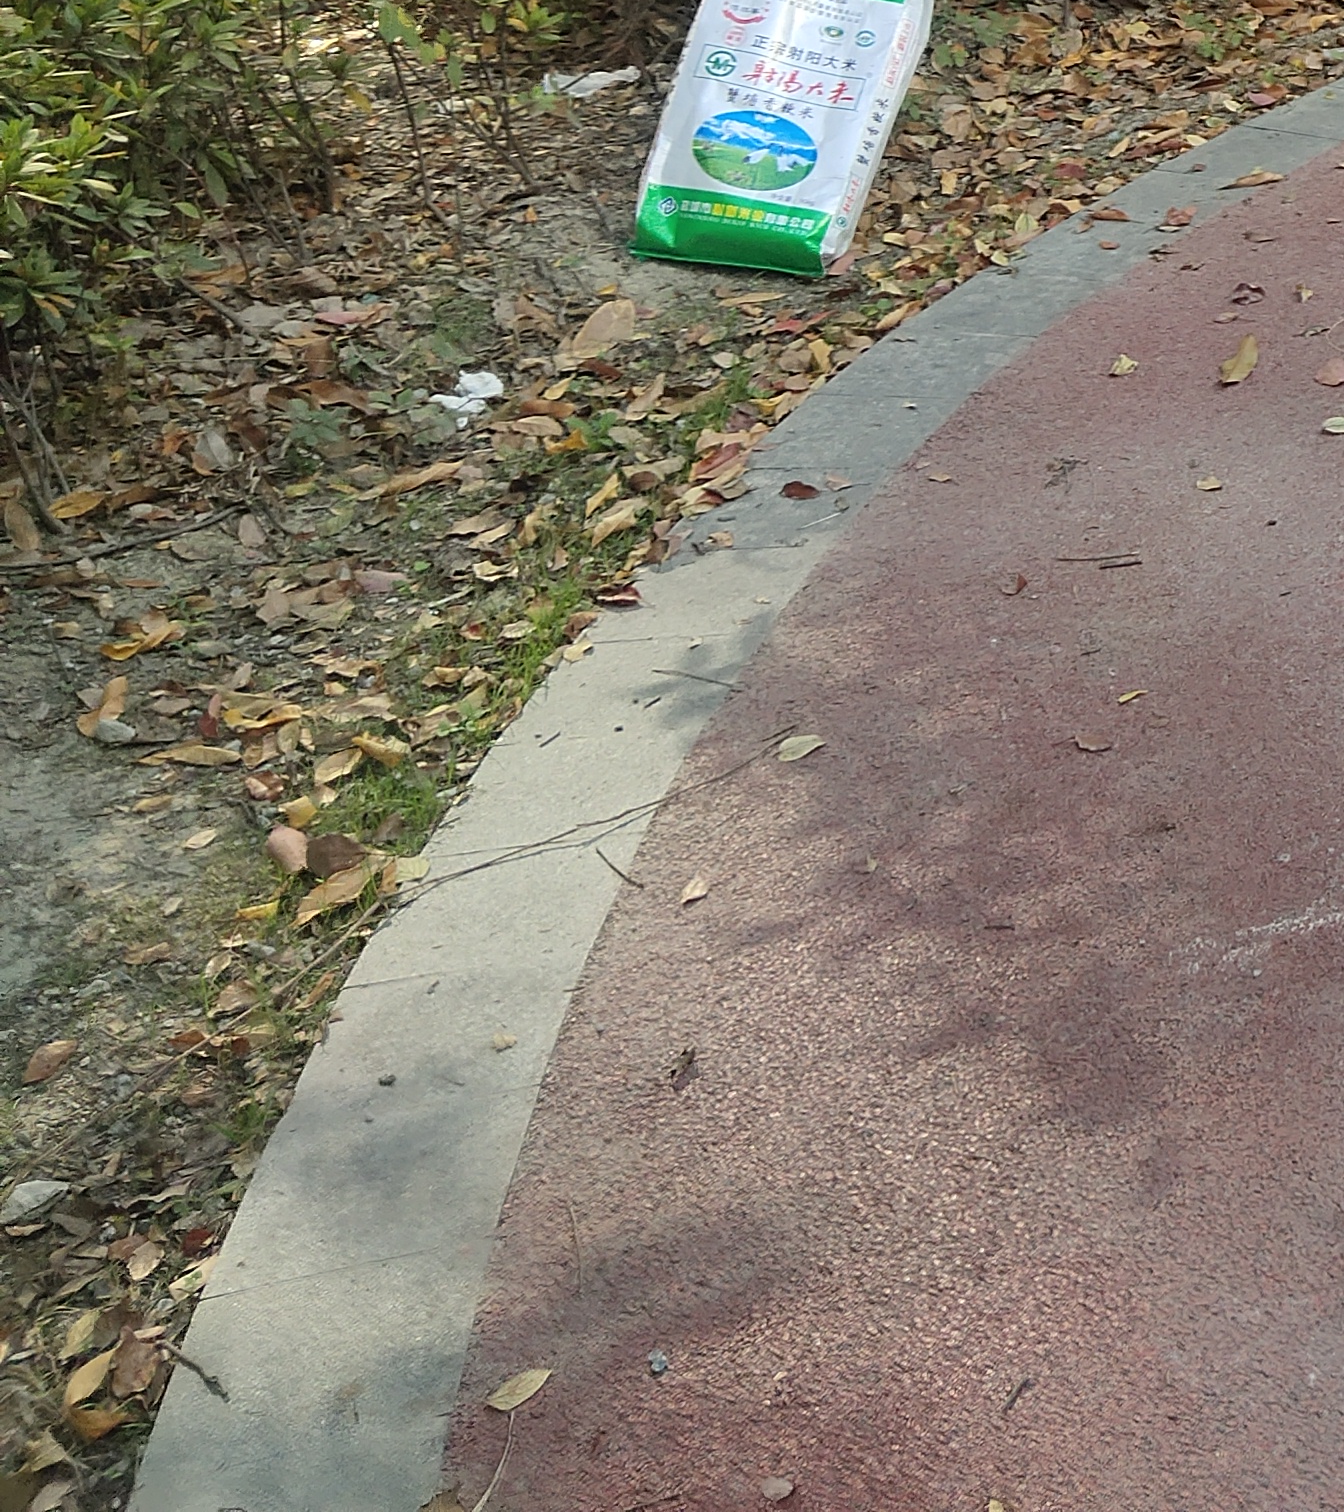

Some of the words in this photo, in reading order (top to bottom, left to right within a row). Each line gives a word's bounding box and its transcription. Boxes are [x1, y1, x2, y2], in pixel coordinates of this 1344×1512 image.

[752, 34, 859, 72] 正宗射阳大米
